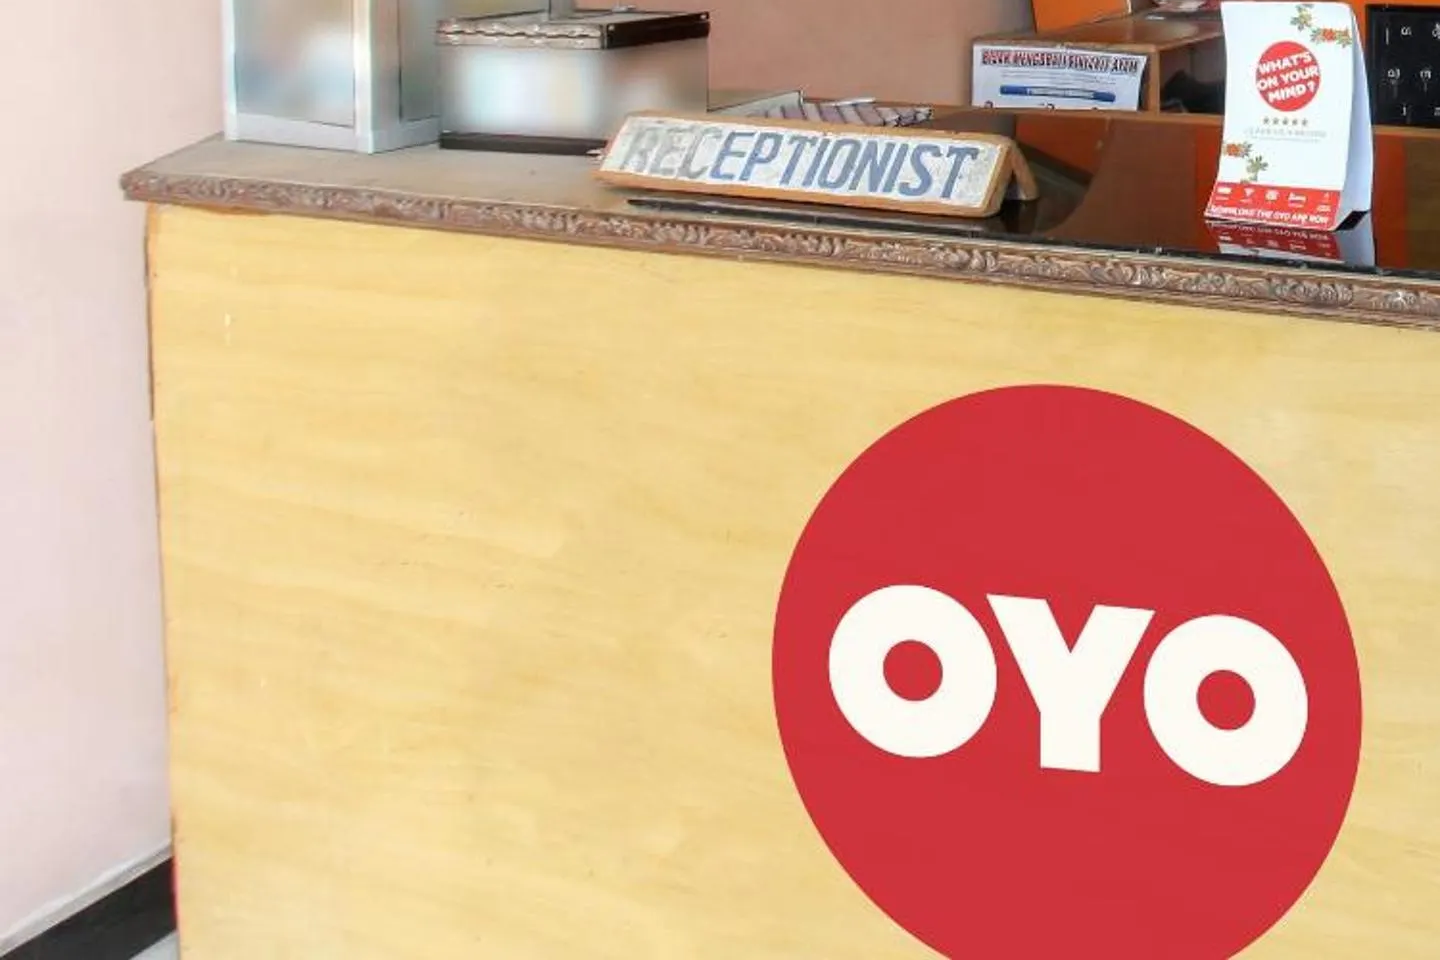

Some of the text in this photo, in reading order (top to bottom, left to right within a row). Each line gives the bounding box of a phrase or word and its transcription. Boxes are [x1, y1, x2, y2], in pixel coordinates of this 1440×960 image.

[1259, 51, 1312, 75] WHAT'S
[1257, 65, 1320, 91] ON YOUR
[1268, 83, 1306, 103] MIND
[618, 124, 980, 200] RECEPTIONIST
[1256, 208, 1272, 218] THE
[1272, 210, 1291, 221] OYO
[1308, 213, 1329, 224] NOW
[828, 584, 1308, 786] OYO
